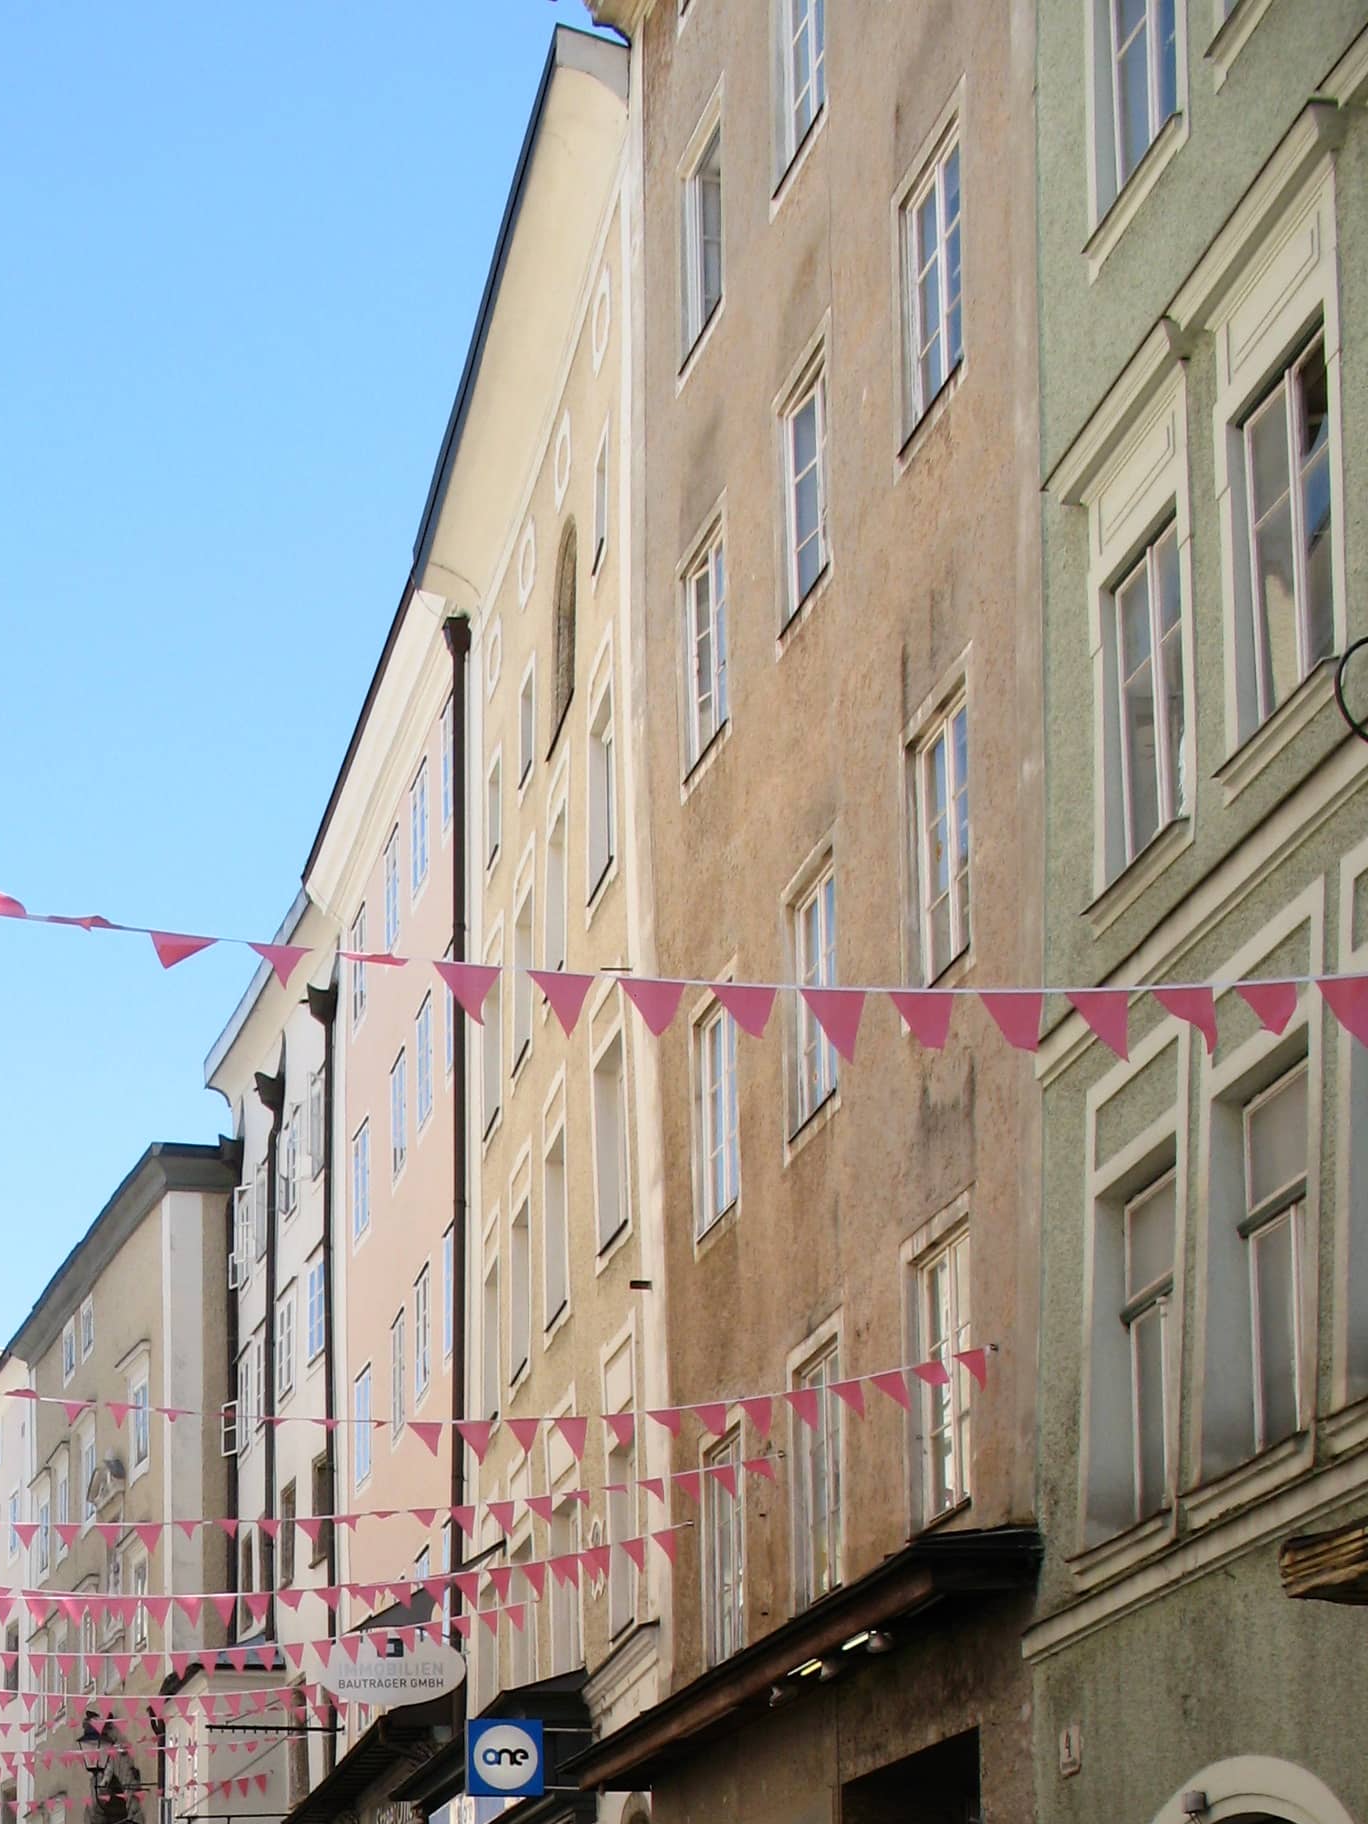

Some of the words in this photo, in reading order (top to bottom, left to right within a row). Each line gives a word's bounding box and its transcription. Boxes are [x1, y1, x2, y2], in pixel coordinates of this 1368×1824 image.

[338, 1662, 444, 1677] IMMOBILIEN
[410, 1678, 444, 1689] GMBH
[482, 1748, 529, 1766] one
